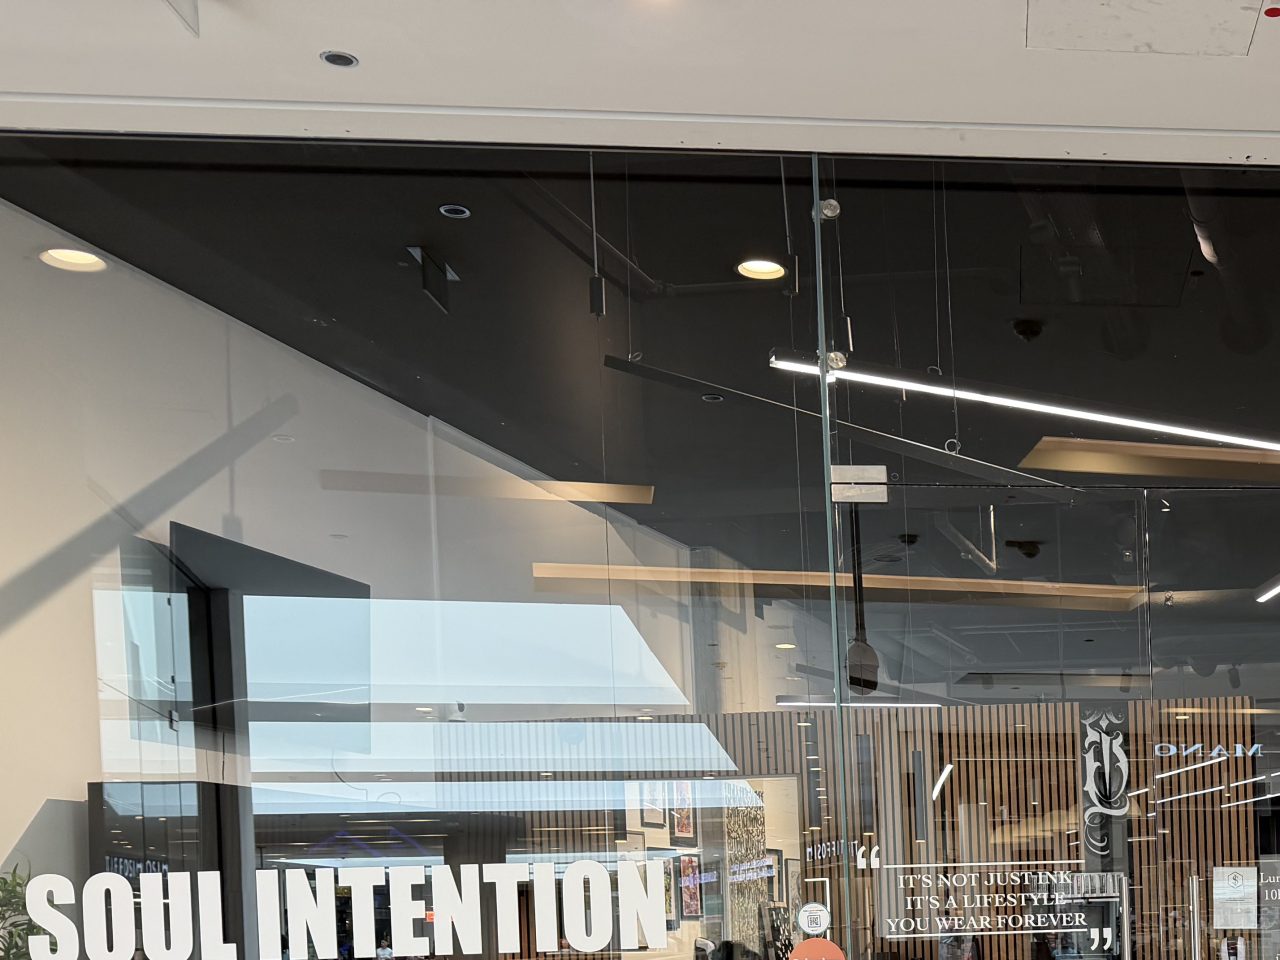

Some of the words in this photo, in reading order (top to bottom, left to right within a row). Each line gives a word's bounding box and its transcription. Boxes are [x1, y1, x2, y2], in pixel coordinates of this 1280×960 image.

[937, 873, 979, 887] NOT
[984, 871, 1032, 886] JUST
[1037, 870, 1072, 885] INK
[256, 859, 669, 960] INTENTION
[905, 895, 940, 910] IT'S
[945, 895, 958, 909] A
[962, 891, 1066, 908] LIFESTYLE
[886, 917, 930, 932] YOU
[935, 915, 993, 930] WEAR
[996, 912, 1088, 928] FOREVER
